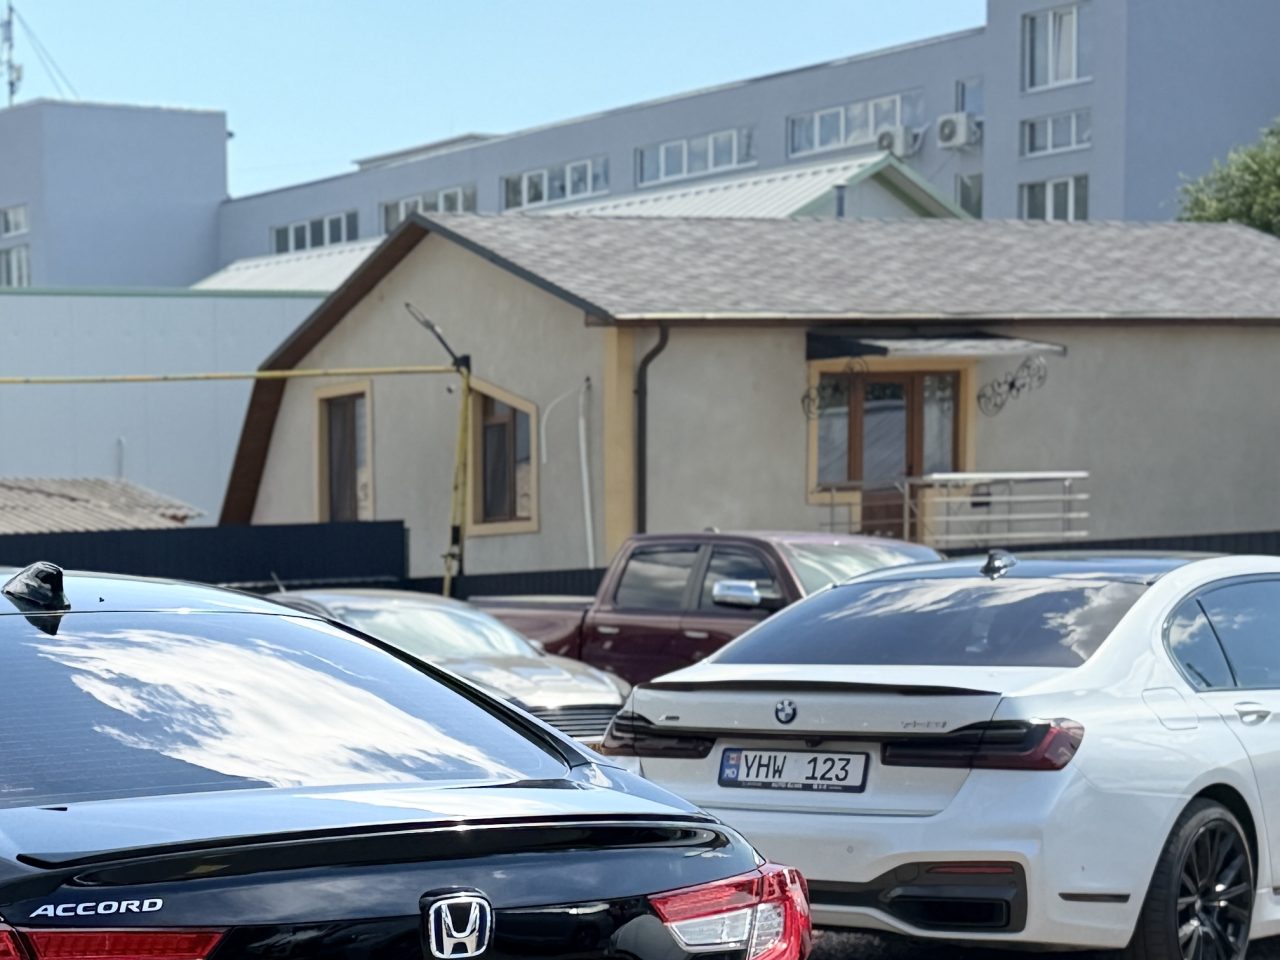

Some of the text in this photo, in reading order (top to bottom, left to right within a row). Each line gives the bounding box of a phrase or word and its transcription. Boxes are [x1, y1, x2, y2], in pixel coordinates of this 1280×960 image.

[744, 754, 851, 782] YHW 123
[29, 898, 163, 917] ACCORD
